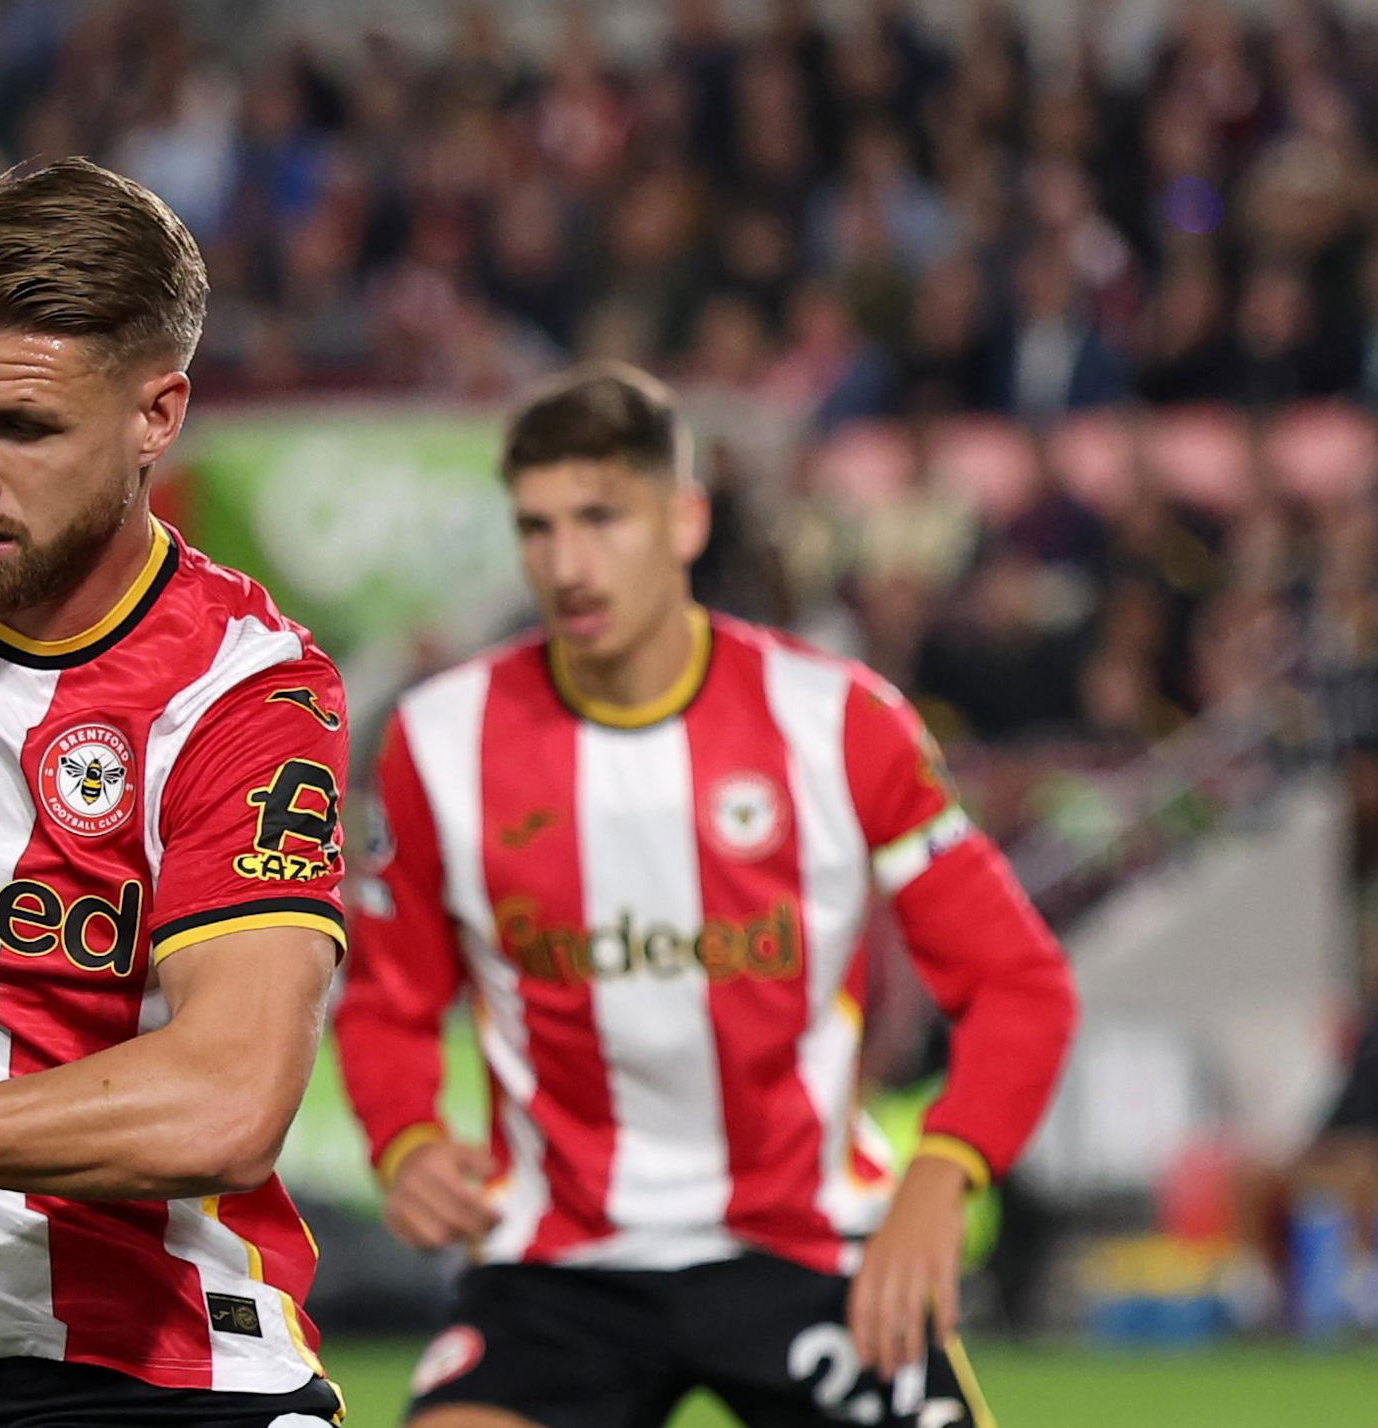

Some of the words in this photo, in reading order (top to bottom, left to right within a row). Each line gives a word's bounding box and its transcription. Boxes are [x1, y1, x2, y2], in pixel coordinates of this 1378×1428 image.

[58, 728, 129, 761] BRENTFORD
[49, 797, 96, 830] FOOTBALL
[98, 809, 123, 828] CLUB
